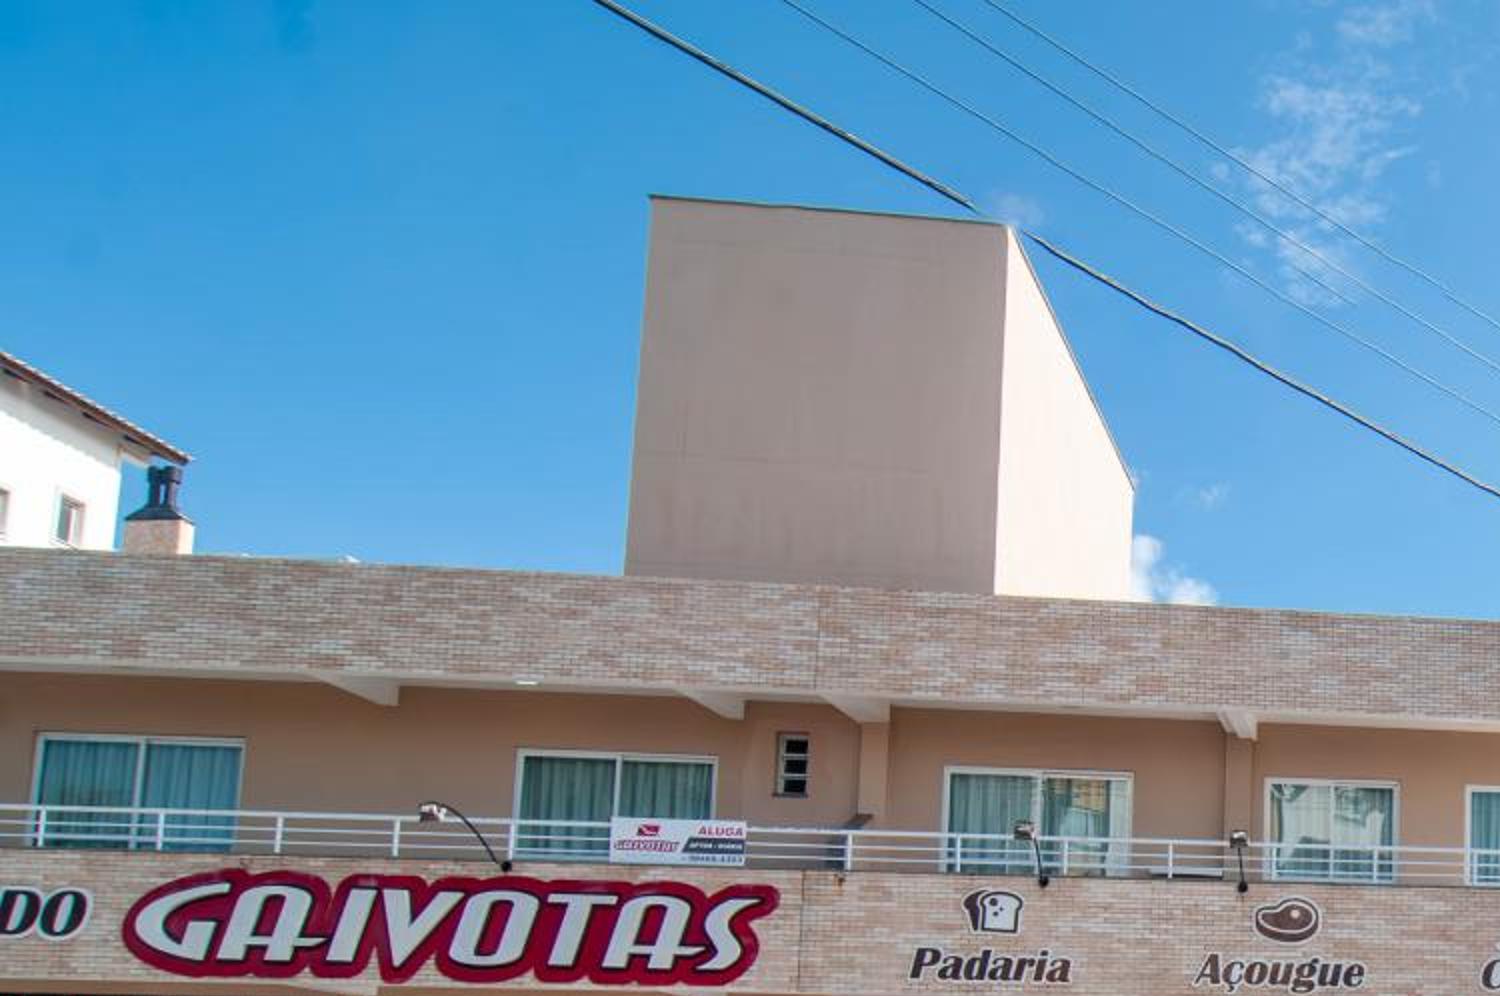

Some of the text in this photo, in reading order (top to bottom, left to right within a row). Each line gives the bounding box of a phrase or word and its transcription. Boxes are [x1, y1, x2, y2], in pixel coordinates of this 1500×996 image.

[698, 825, 743, 836] ALUGA
[134, 882, 762, 971] GAIVOTAS
[908, 946, 1071, 985] Padaria
[1194, 952, 1366, 994] Açougue
